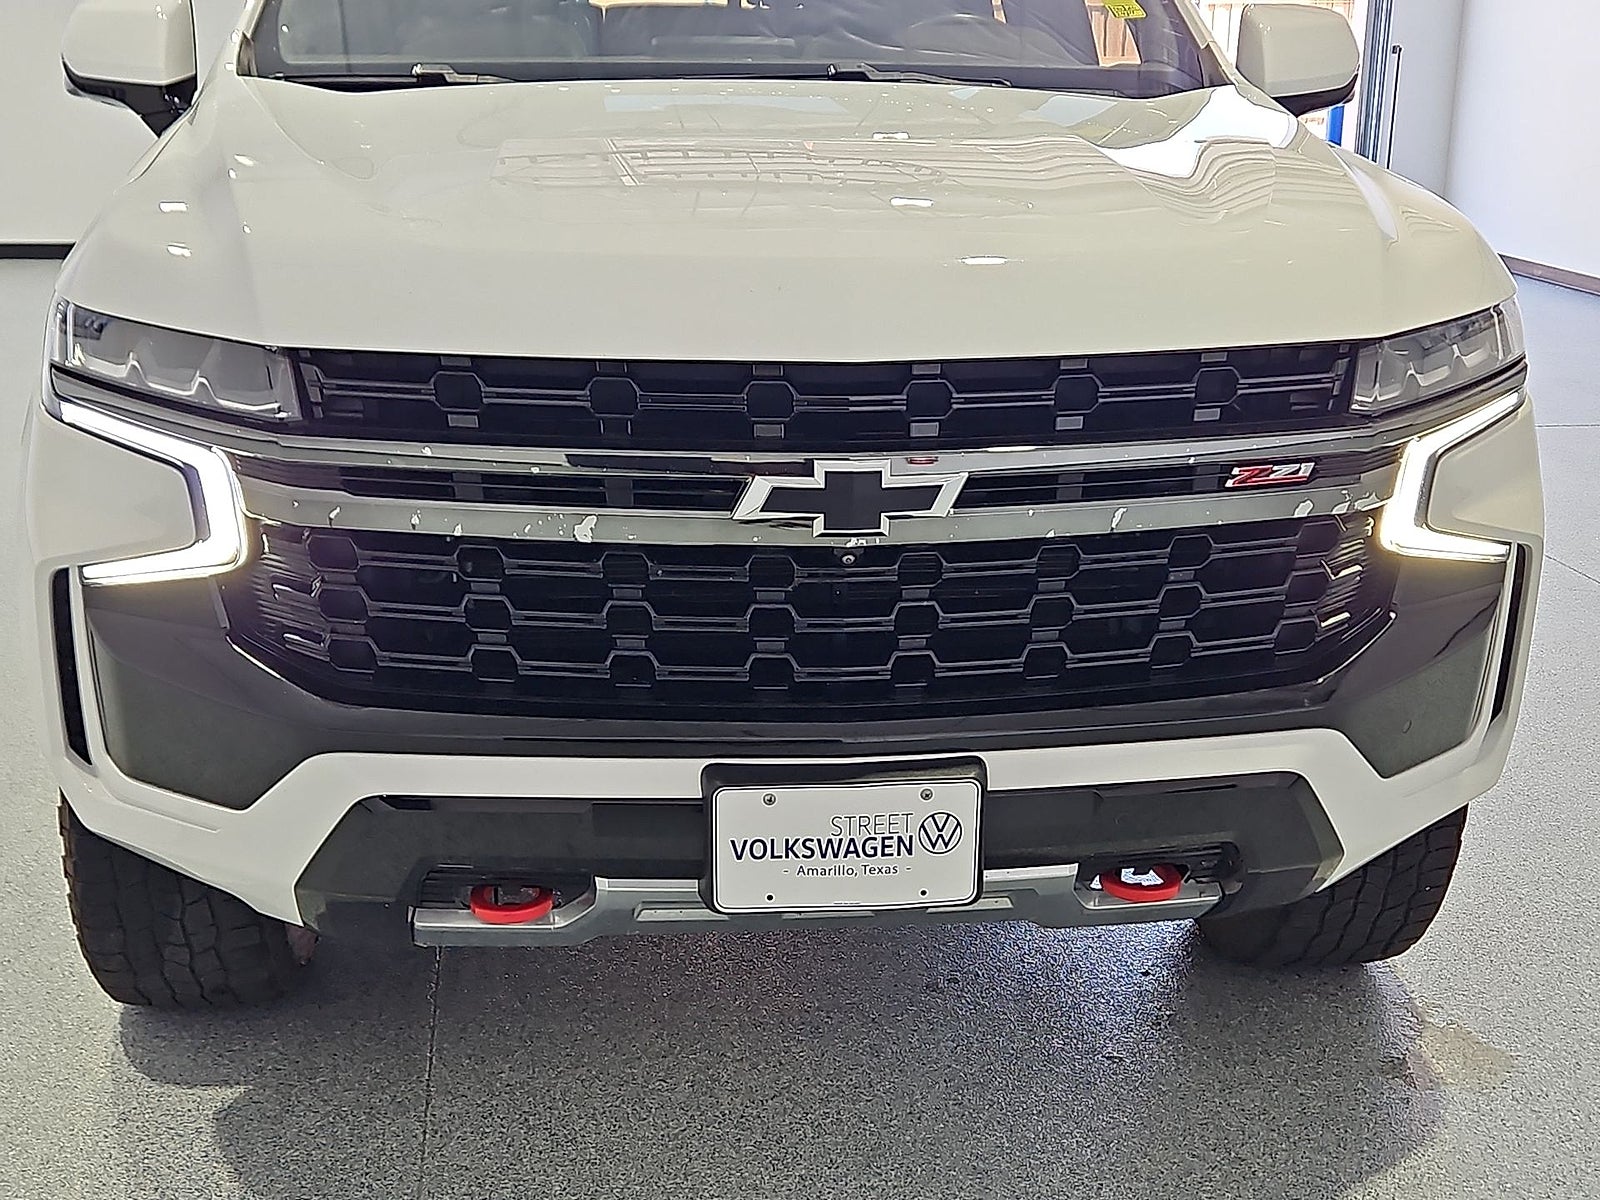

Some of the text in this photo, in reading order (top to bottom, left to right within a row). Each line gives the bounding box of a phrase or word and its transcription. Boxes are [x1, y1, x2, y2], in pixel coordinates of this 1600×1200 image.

[1224, 462, 1315, 487] Z71
[831, 813, 914, 836] STREET
[730, 834, 913, 861] VOLKSWAGEN
[796, 865, 858, 877] Amarillo,
[862, 864, 898, 876] Texas
